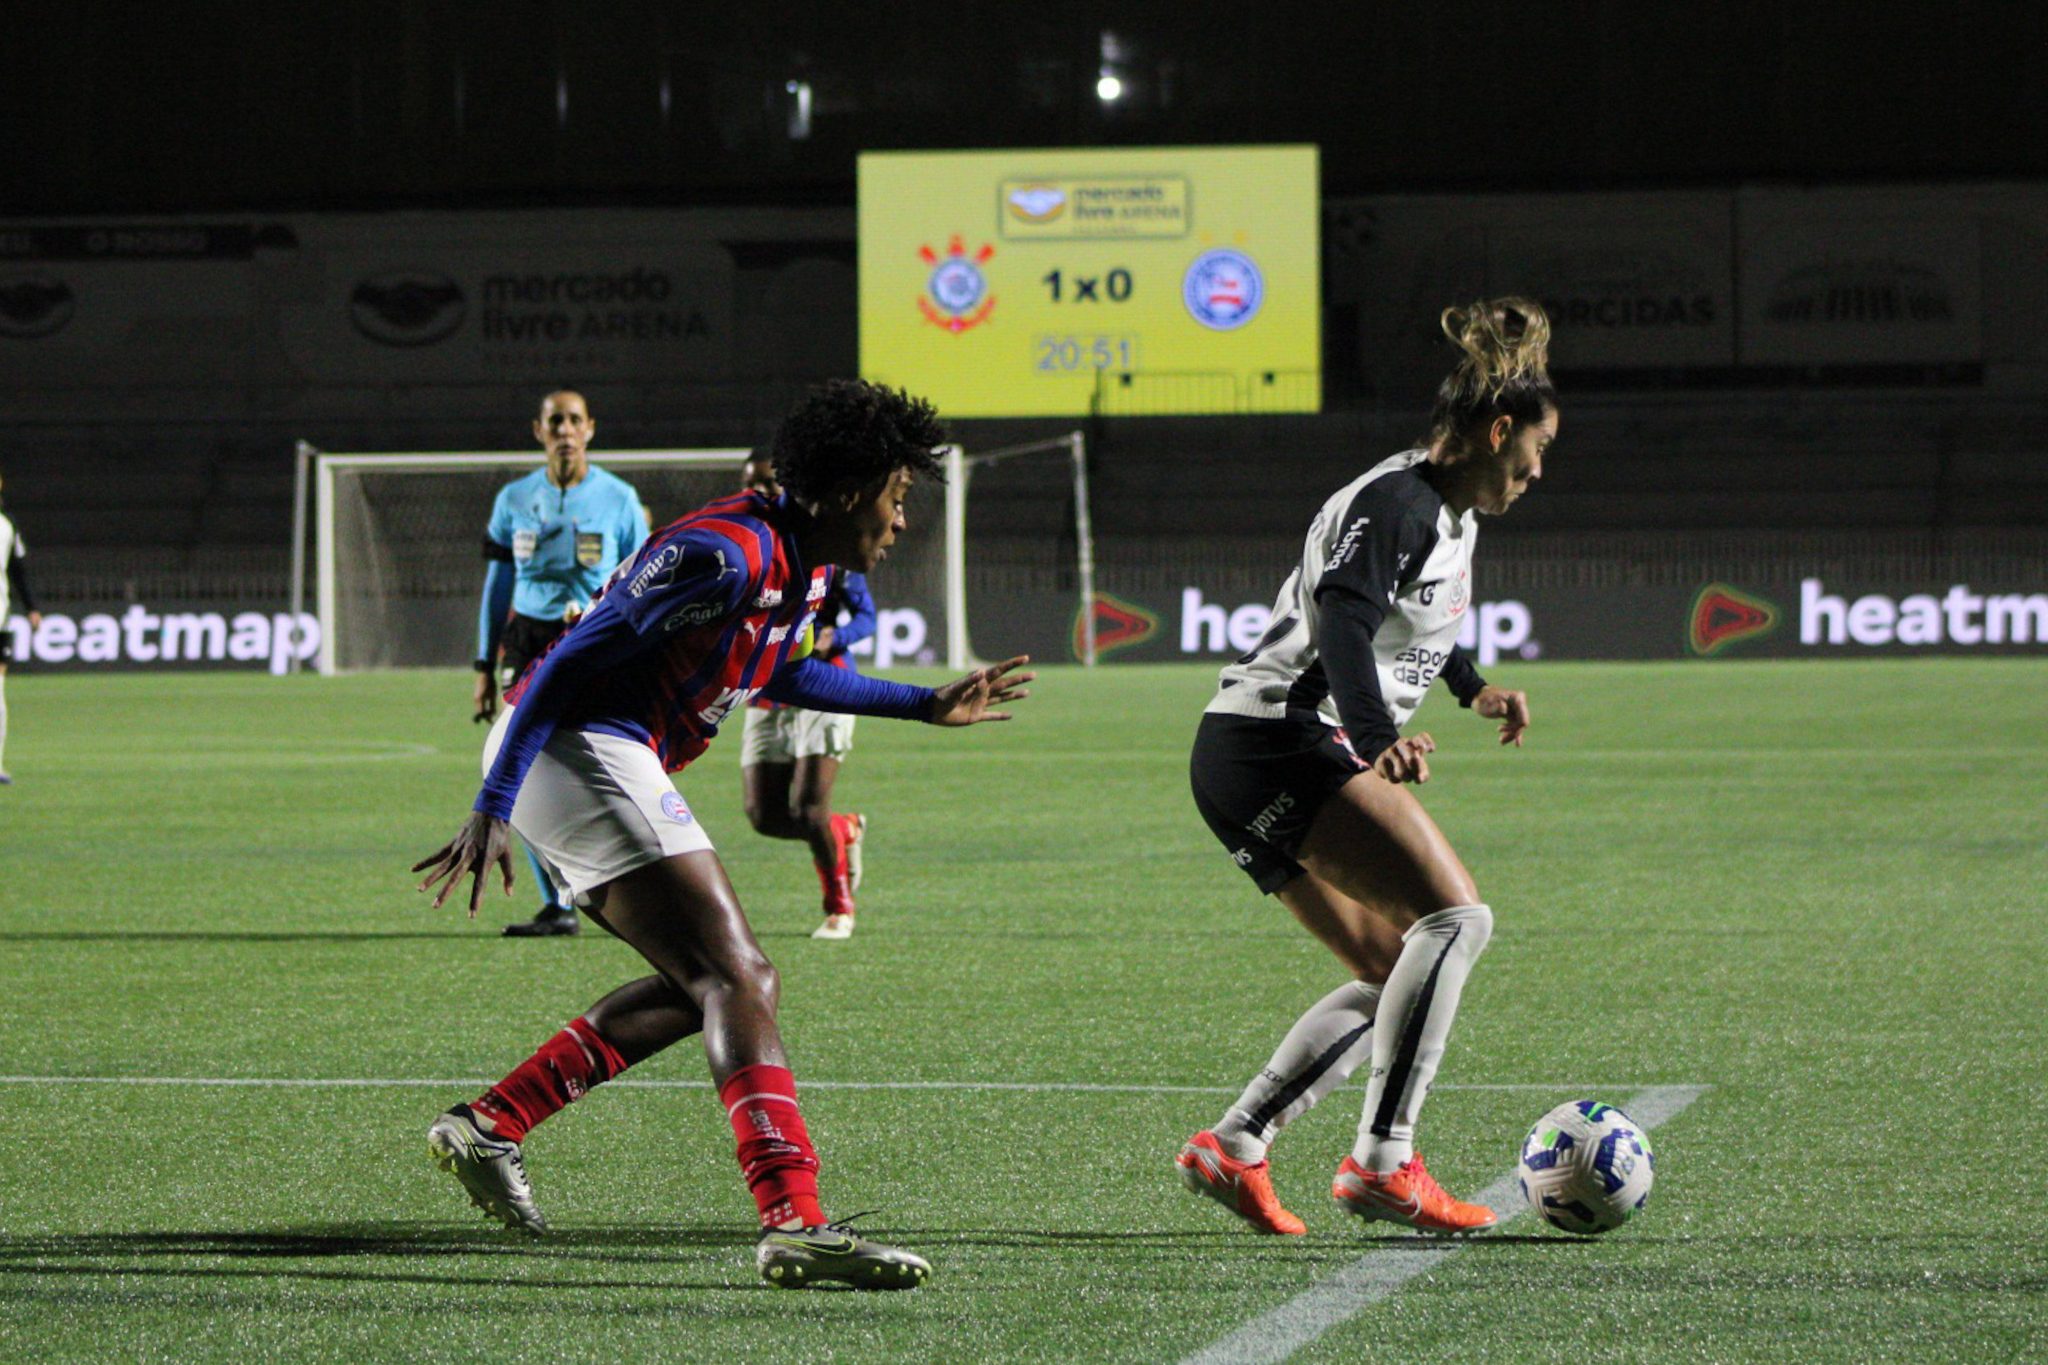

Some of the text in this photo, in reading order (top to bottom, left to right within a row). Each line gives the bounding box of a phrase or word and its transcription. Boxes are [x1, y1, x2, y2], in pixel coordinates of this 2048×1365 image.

[483, 265, 670, 303] mercado
[1043, 268, 1133, 302] 1 x 0
[483, 308, 571, 342] livre
